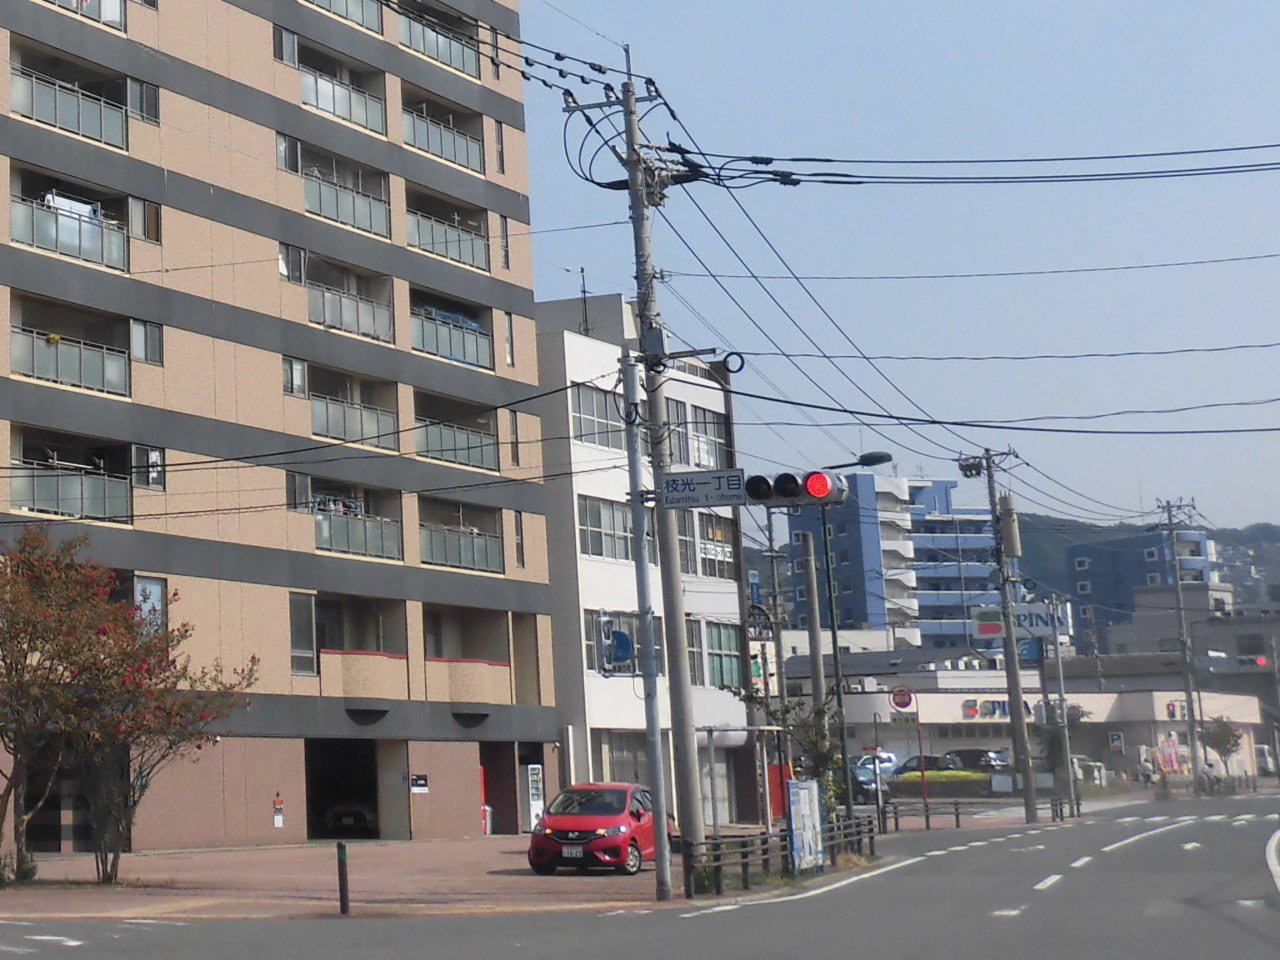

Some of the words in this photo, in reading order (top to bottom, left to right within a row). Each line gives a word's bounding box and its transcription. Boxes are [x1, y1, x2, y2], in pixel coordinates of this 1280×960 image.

[665, 476, 741, 493] 枝光一丁目
